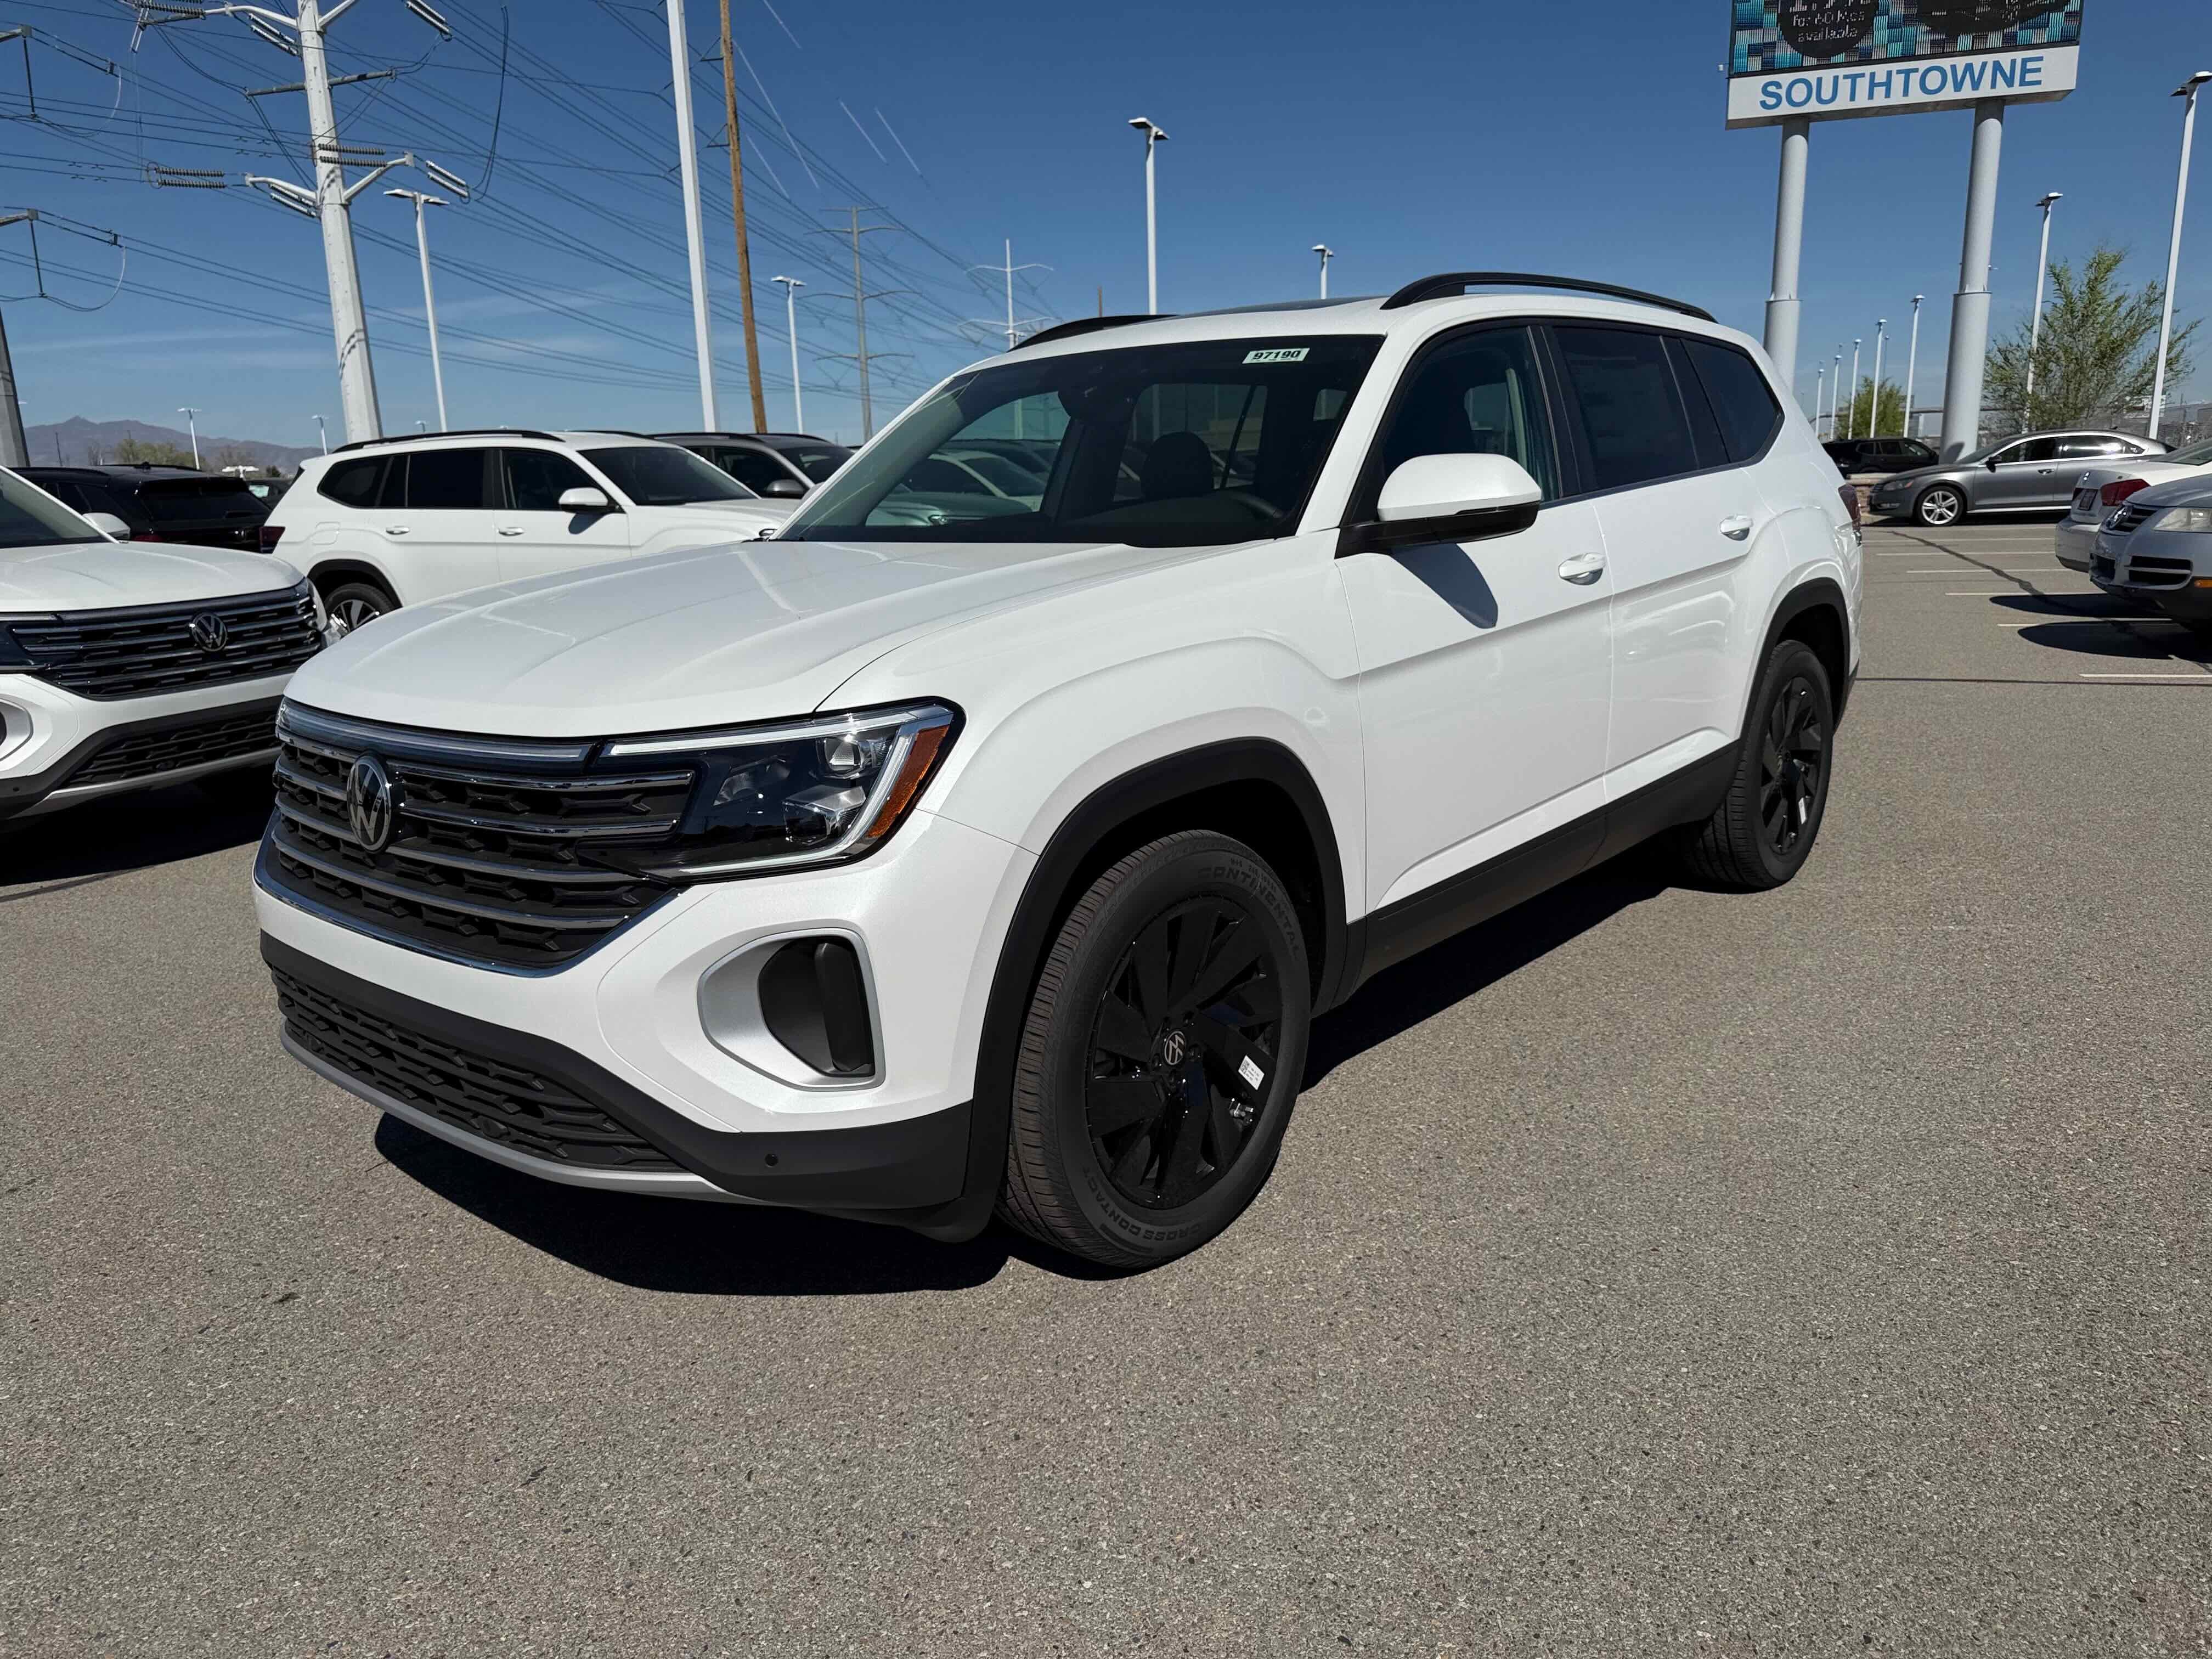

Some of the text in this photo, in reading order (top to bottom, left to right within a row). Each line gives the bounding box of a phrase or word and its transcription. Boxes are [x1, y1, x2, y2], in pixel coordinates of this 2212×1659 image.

[1798, 24, 1858, 42] available
[1759, 56, 2045, 110] SOUTHTOWNE
[1253, 350, 1301, 359] 97190
[1142, 1222, 1203, 1242] CROSS
